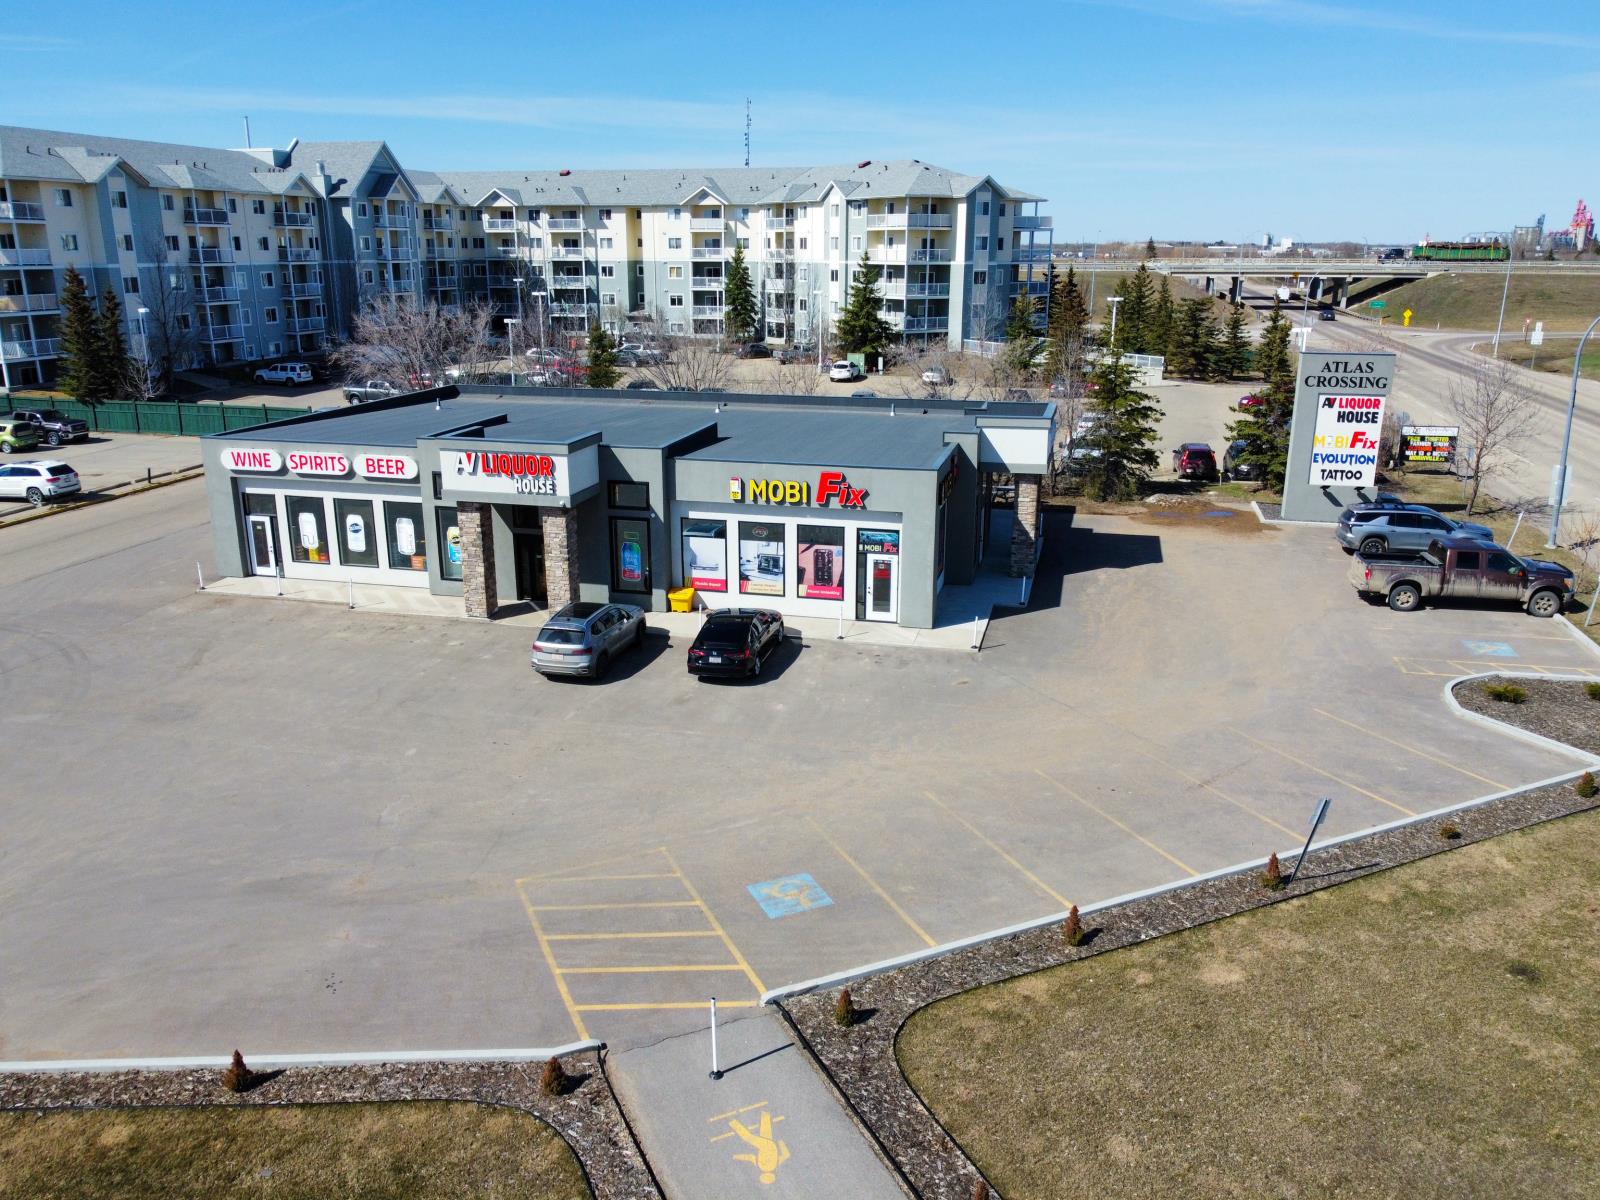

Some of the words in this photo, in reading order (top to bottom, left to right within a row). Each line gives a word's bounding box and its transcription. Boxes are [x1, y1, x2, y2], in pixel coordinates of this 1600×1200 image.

[1320, 361, 1375, 374] ATLAS
[1304, 375, 1388, 389] CROSSING
[1338, 397, 1381, 410] LIQUOR
[1337, 411, 1379, 424] HOUSE
[230, 450, 272, 468] WINE
[289, 454, 347, 472] SPIRITS
[366, 457, 405, 475] BEER
[480, 452, 553, 477] LIQUOR
[1312, 453, 1376, 466] EVOLUTION
[1320, 468, 1363, 483] TATTOO
[513, 478, 554, 495] HOUSE
[749, 479, 808, 504] MOBI
[815, 471, 866, 507] Fix
[864, 544, 882, 552] MOBI
